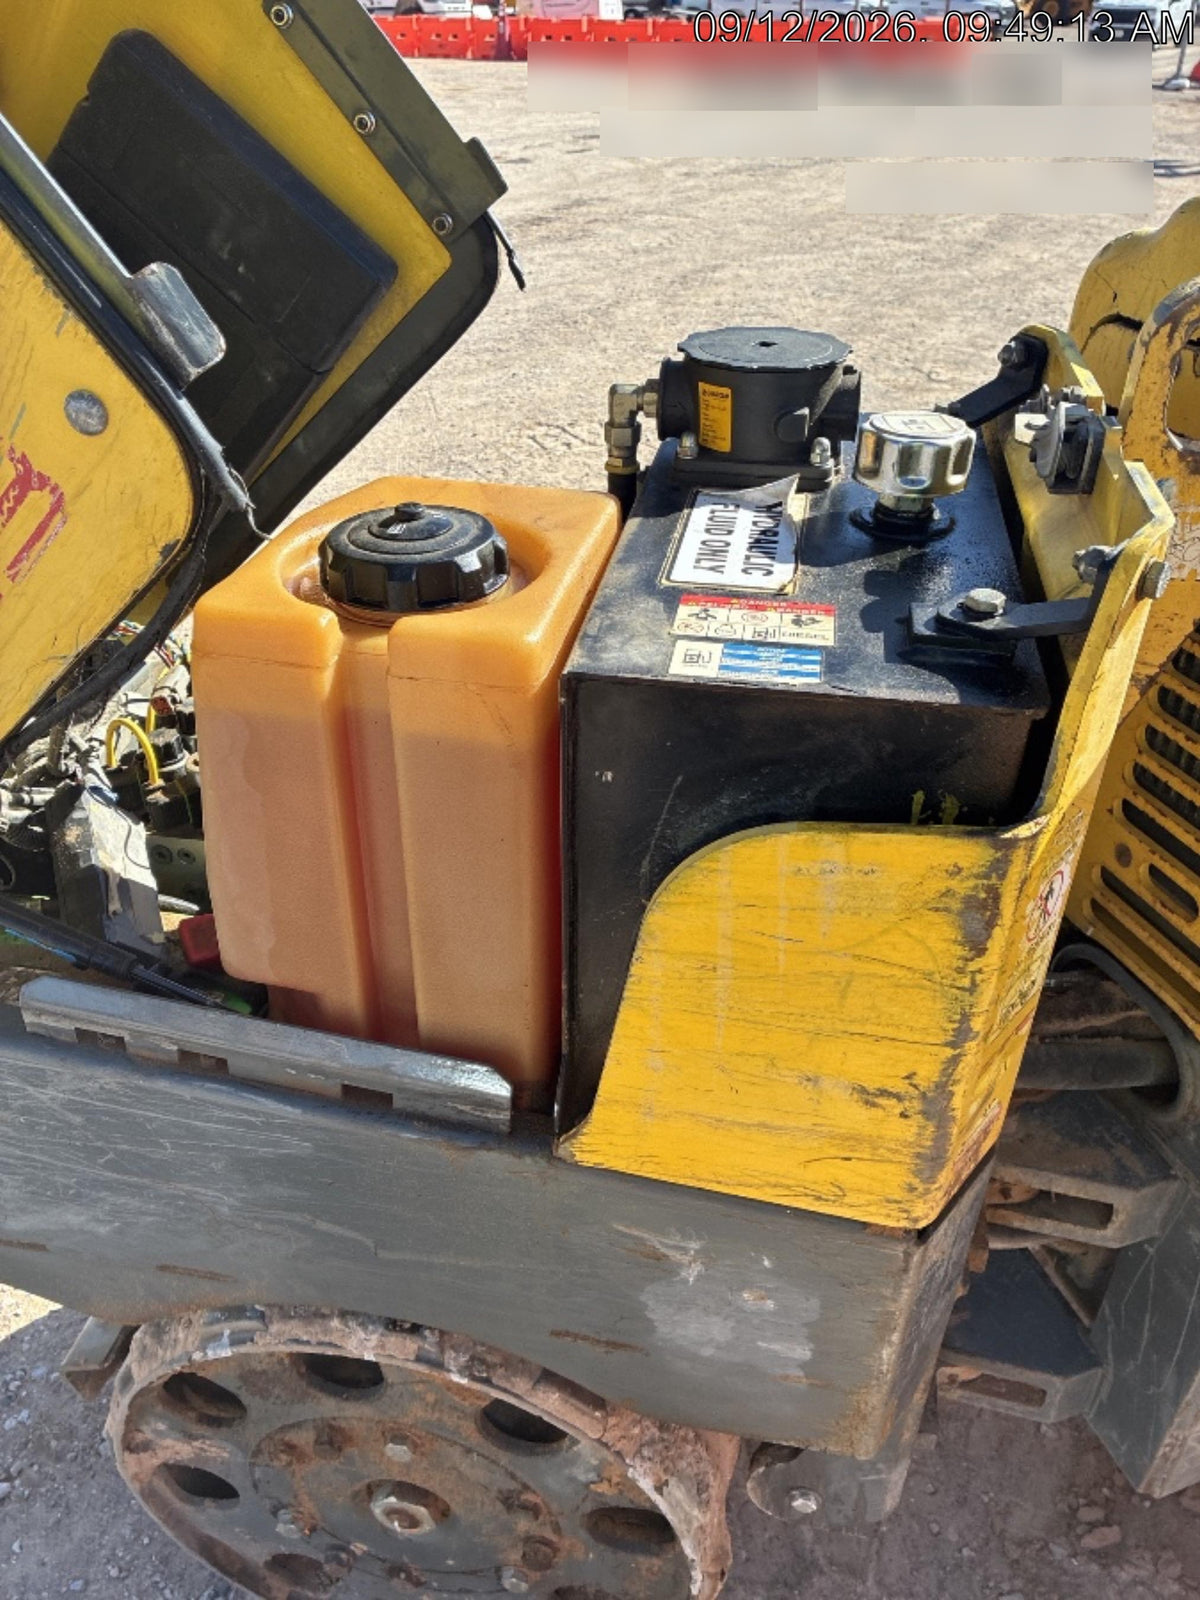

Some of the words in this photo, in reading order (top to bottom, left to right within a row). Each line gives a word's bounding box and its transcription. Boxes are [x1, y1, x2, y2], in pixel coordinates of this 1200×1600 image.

[704, 502, 740, 536] FLUID
[741, 500, 783, 576] HYDRAULIC
[693, 539, 731, 574] ONLY
